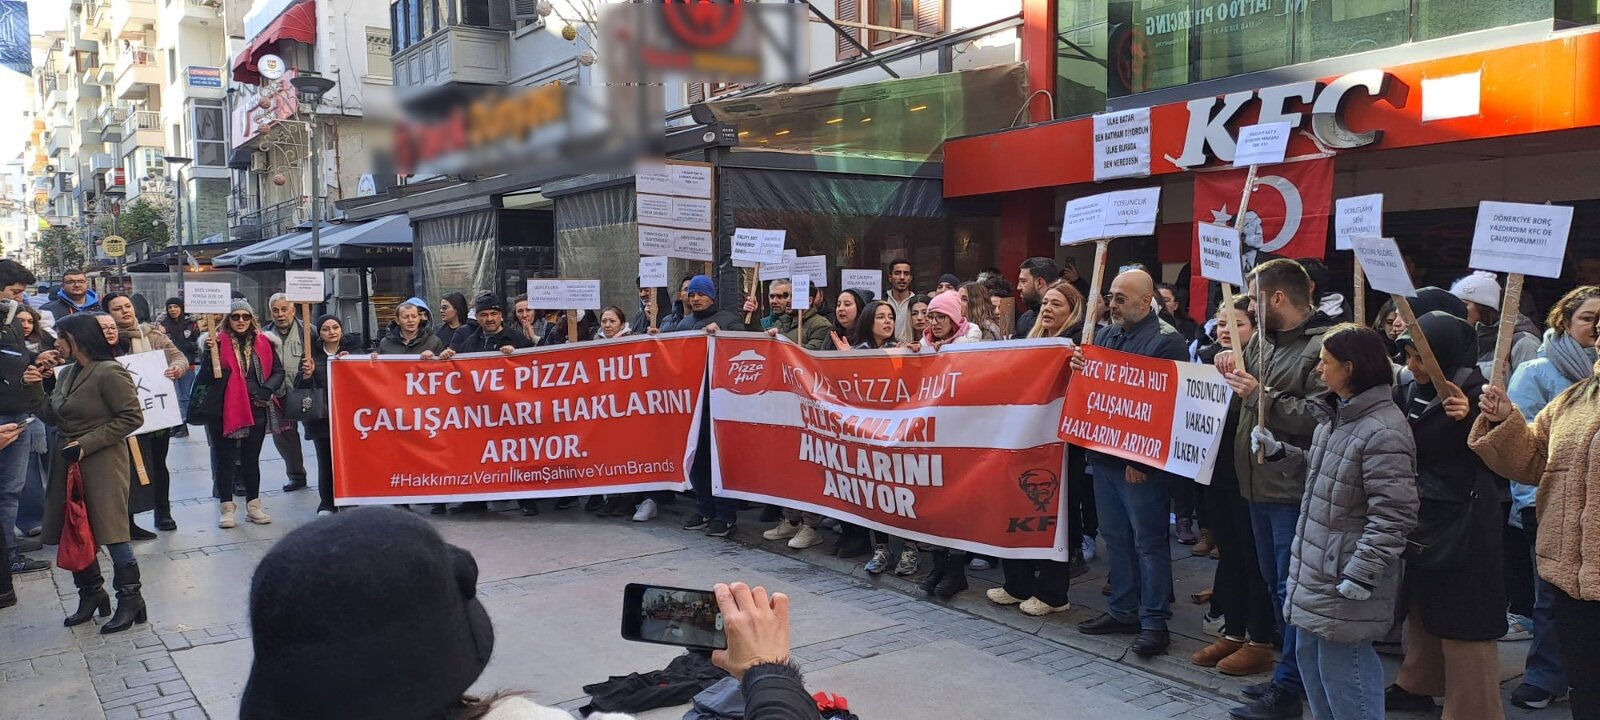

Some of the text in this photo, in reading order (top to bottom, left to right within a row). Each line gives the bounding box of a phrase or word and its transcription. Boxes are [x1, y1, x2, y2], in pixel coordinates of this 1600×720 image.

[1119, 113, 1135, 124] BATAR
[1177, 69, 1385, 167] KFC
[1095, 133, 1104, 142] BEN
[1105, 142, 1137, 155] ÜLKE BURADA
[1103, 160, 1113, 169] SEN
[1113, 198, 1147, 207] TOSUNCUK
[1117, 208, 1139, 216] VAKASI
[1489, 224, 1527, 234] YAZDIRDIM
[1493, 213, 1552, 226] DÖNERCİYE BORÇ
[1221, 235, 1232, 248] SAT
[404, 352, 652, 396] KFC VE PİZZA HUT
[728, 359, 766, 377] Pizza
[734, 370, 762, 385] Hut
[1081, 358, 1169, 393] KFC VE PİZZA HUT
[781, 362, 804, 388] KFC
[838, 372, 910, 403] PİZZA
[918, 372, 962, 399] HUT
[1186, 378, 1227, 405] TOSUNCUK
[353, 388, 692, 439] ÇALIŞANLARI HAKLARINI
[1086, 391, 1153, 422] ÇALIŞANLARI
[800, 402, 936, 443] ÇALIŞANLARI
[1185, 410, 1214, 436] VAKASI
[480, 433, 588, 464] ARIYOR.
[1060, 415, 1162, 459] HAKLARINI ARIYOR
[1173, 436, 1199, 464] İLKEM
[799, 431, 944, 487] HAKLARINI
[823, 470, 917, 519] ARIYOR
